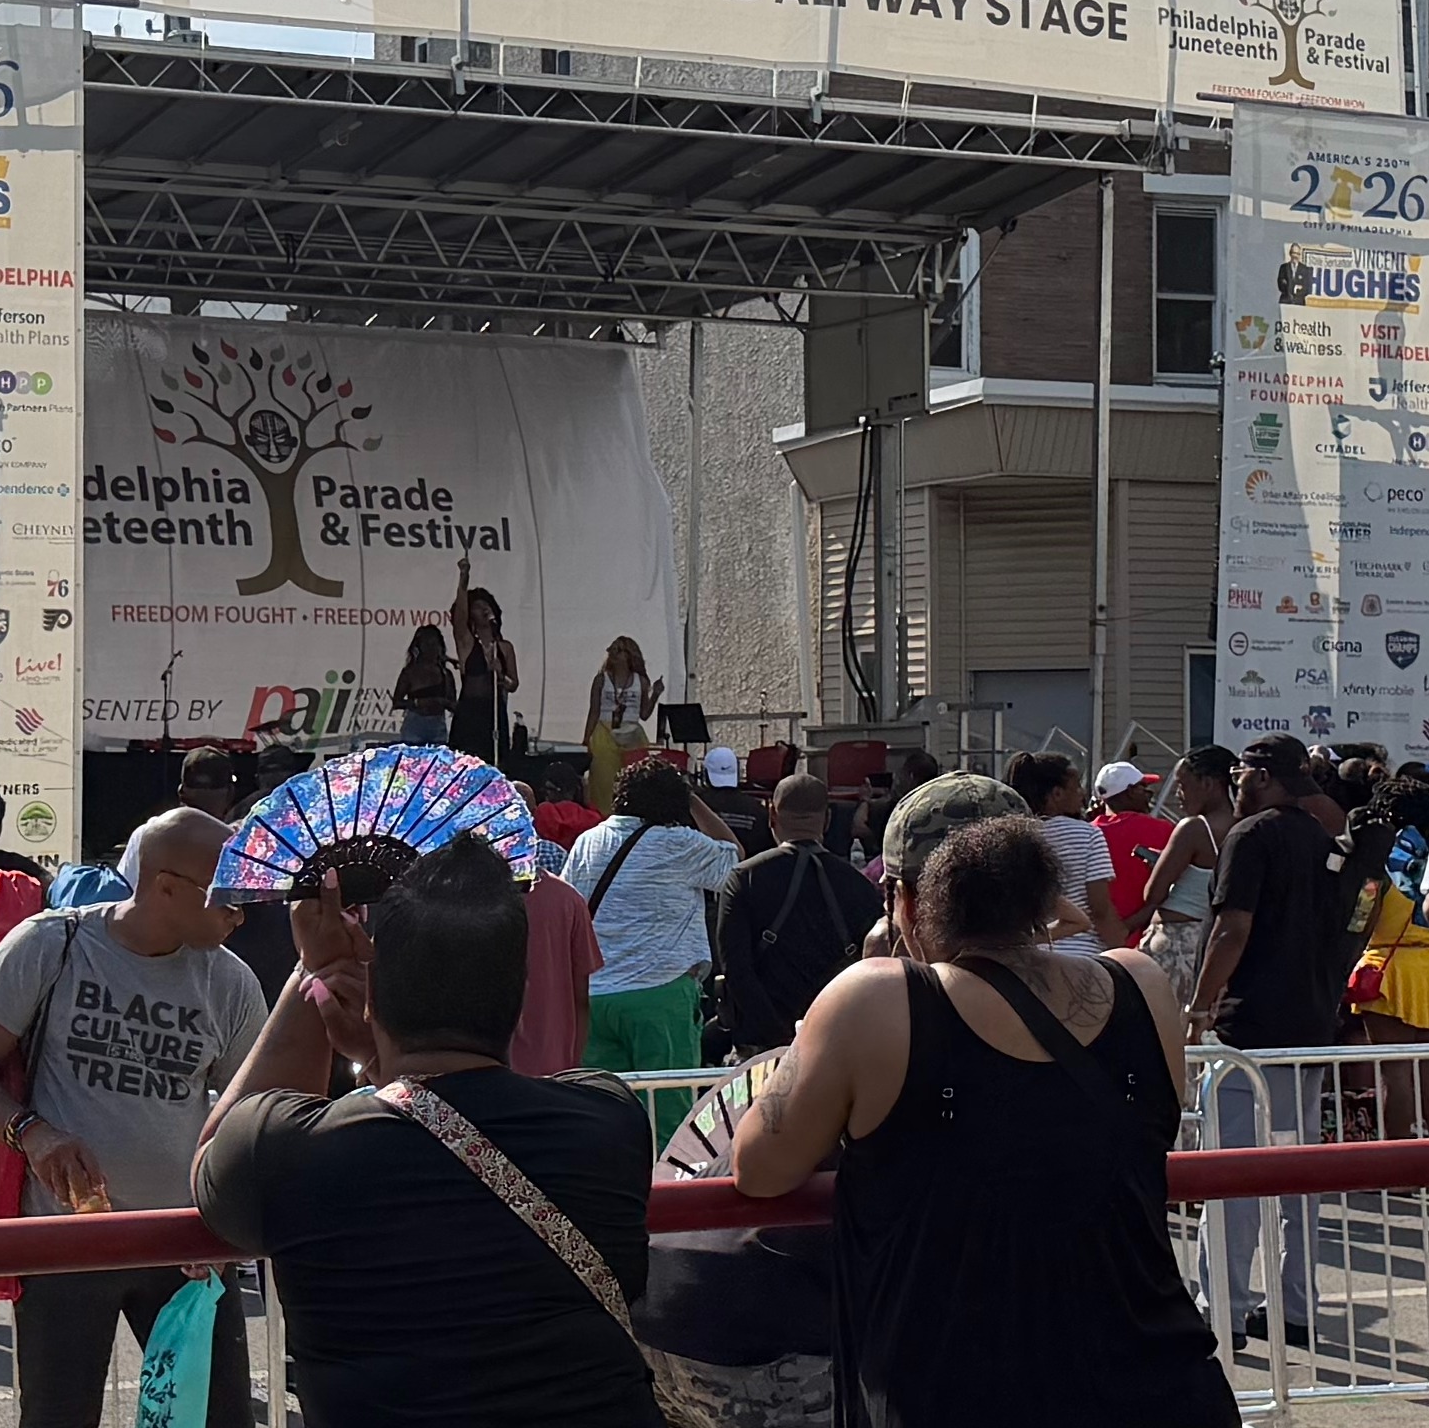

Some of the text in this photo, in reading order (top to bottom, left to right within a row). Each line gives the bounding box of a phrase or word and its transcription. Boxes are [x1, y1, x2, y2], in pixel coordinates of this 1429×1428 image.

[1158, 6, 1278, 43] Philadelphia
[1168, 31, 1278, 63] Juneteenth
[1304, 27, 1366, 52] Parade
[1306, 46, 1390, 75] & Festival
[1343, 98, 1365, 109] WON
[1307, 151, 1372, 166] AMERICA'S
[1353, 248, 1407, 272] VINCENT
[1308, 267, 1420, 303] HUGHES
[29, 330, 70, 347] Plans
[1275, 319, 1331, 337] pa health
[1360, 324, 1400, 341] VISIT
[1239, 371, 1343, 388] PHILADELPHIA
[7, 403, 47, 413] Partners
[1251, 389, 1344, 406] FOUNDATION
[1315, 443, 1365, 455] CITADEL
[84, 464, 250, 511] delphia
[312, 475, 453, 512] Parade
[1387, 487, 1423, 503] peco
[84, 509, 253, 546] eteenth
[320, 512, 511, 552] & Festival
[1329, 527, 1371, 540] WATER
[1227, 588, 1263, 603] PHILLY
[111, 604, 454, 628] FREEDOM FOUGHT FREEDOM WON
[15, 653, 62, 676] Live!
[1295, 668, 1328, 684] PSA
[1342, 684, 1377, 697] xfinity
[1379, 685, 1414, 697] mobile
[83, 698, 223, 721] SENTED BY
[1243, 717, 1289, 731] aetna
[75, 980, 202, 1035] BLACK
[70, 1014, 203, 1063] CULTURE
[66, 1053, 190, 1101] TREND
